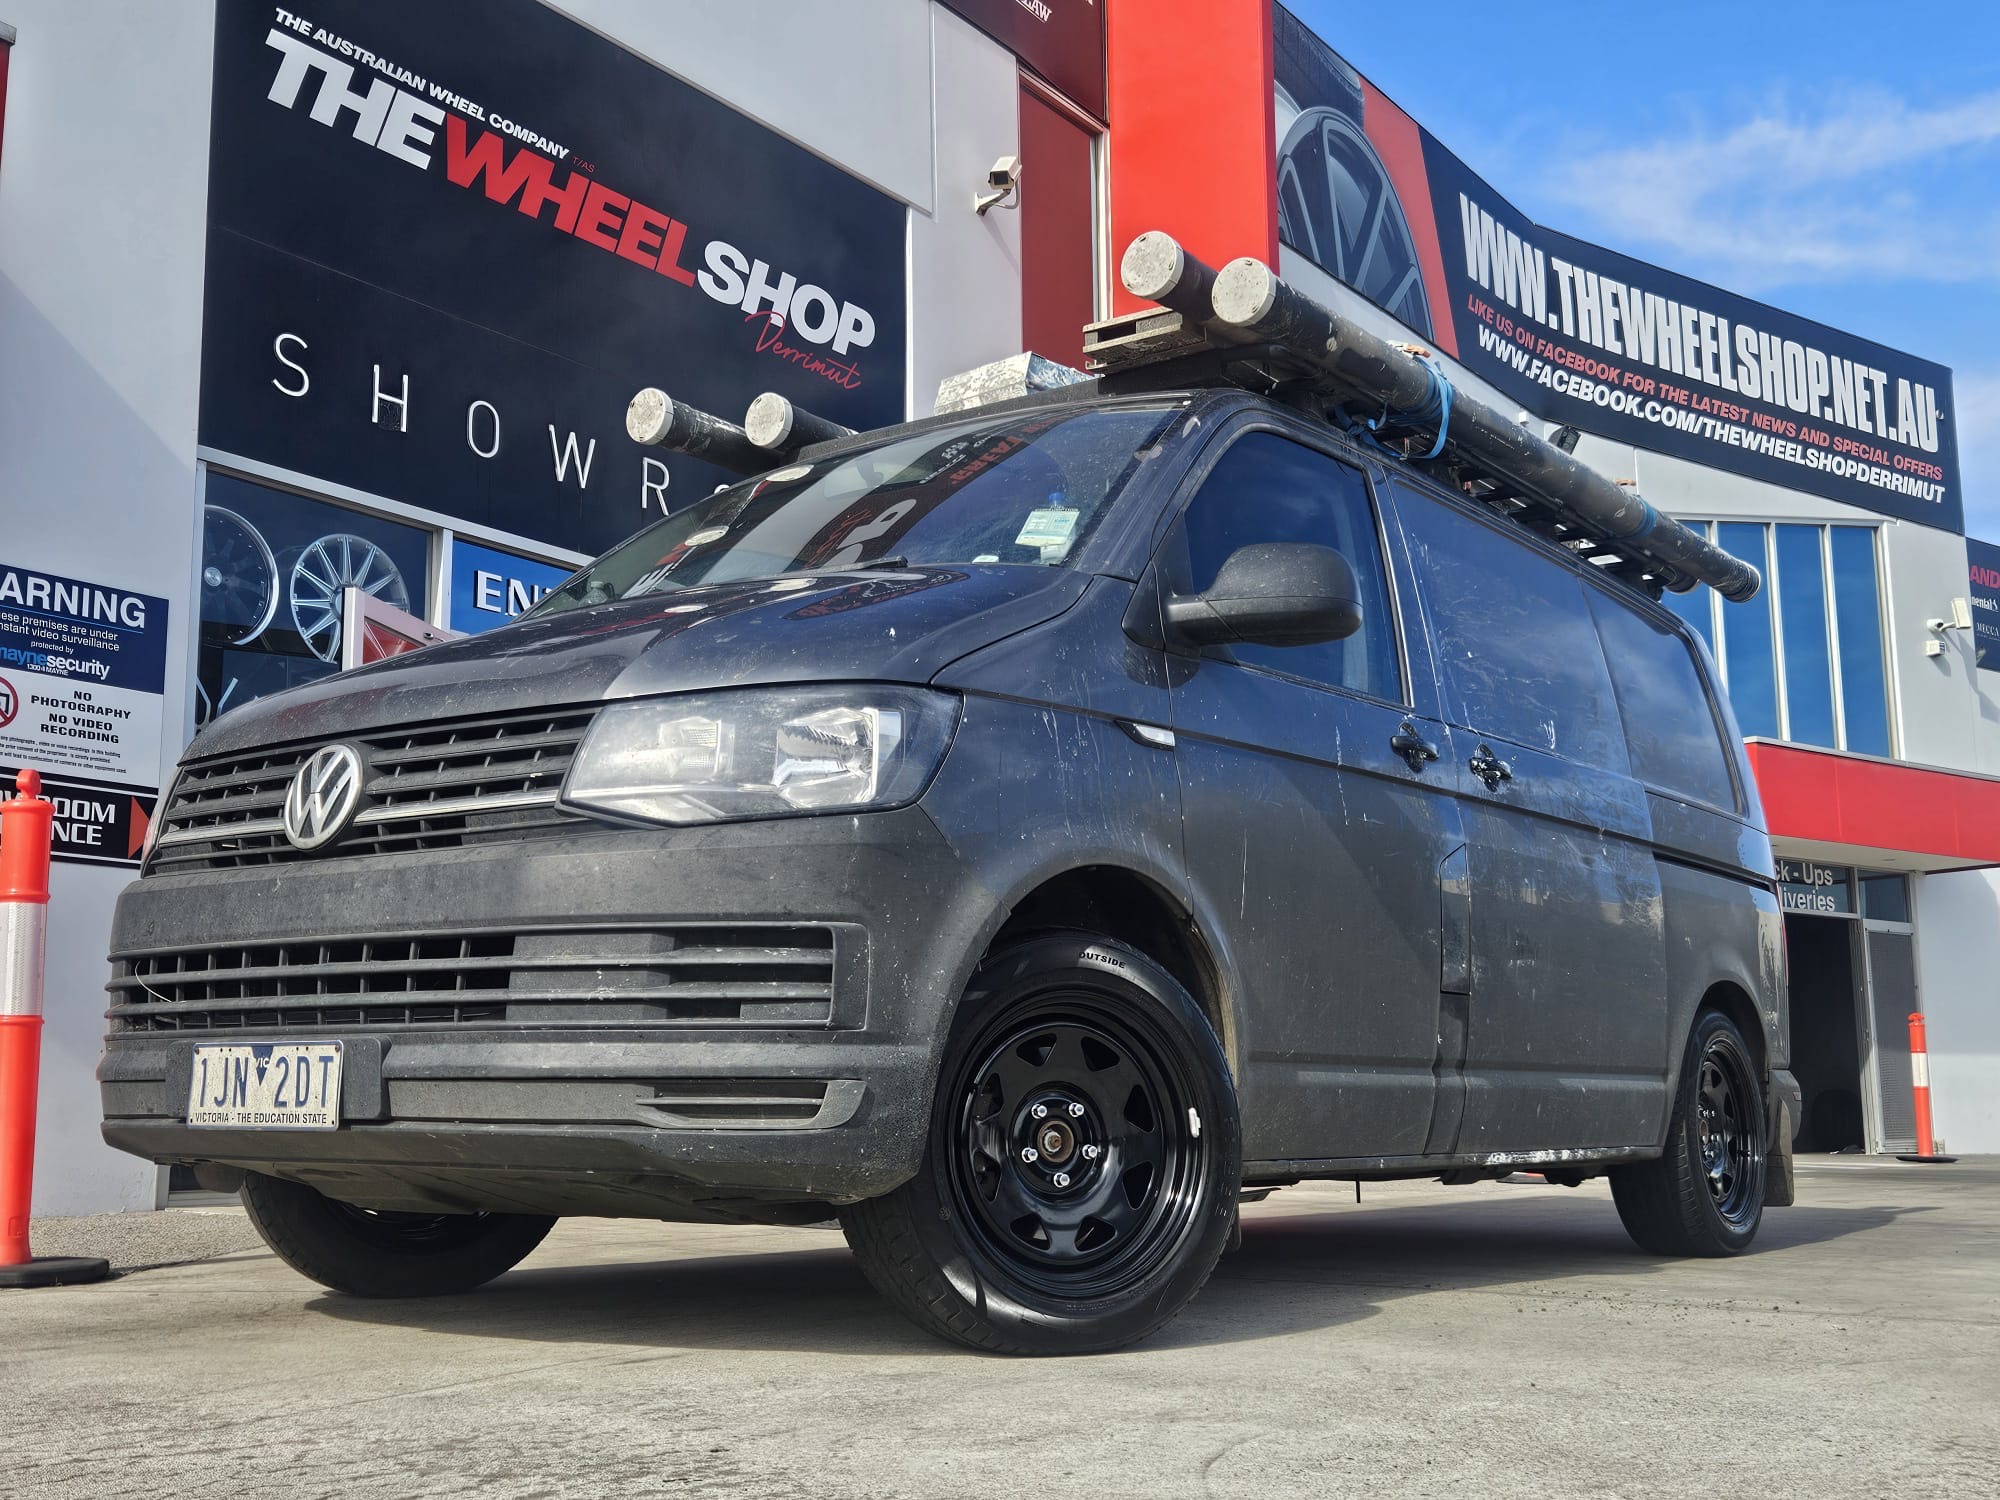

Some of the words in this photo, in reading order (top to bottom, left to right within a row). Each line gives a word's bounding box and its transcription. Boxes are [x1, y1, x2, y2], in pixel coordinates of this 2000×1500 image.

[275, 7, 312, 36] THE
[313, 28, 426, 91] AUSTRALIAN
[429, 82, 486, 122] WHEEL
[489, 113, 570, 160] COMPANY
[573, 156, 595, 173] T/AS
[265, 28, 446, 171] THE
[446, 112, 696, 288] WHEEL
[698, 240, 876, 355] SHOP
[1459, 191, 1939, 453] WWW.THEWHEELSHOP.NET.AU
[1467, 293, 1494, 325] LIKE
[1496, 315, 1513, 337] US
[1515, 327, 1537, 350] ON
[1536, 338, 1621, 384] FACEBOOK
[1622, 371, 1656, 395] FOR
[1659, 383, 1690, 404] THE
[1691, 392, 1750, 423] LATEST
[1751, 410, 1797, 438] NEWS
[1799, 426, 1830, 447] AND
[1832, 436, 1891, 466] SPECIAL
[1893, 454, 1943, 481] OFFERS
[273, 333, 730, 516] SHOWR
[1478, 324, 1946, 503] WWW.FACEBOOK.COM/THEWHEELSHOPDERRIMUT
[475, 569, 553, 617] EN
[22, 615, 69, 632] premises
[71, 625, 87, 636] are
[90, 627, 118, 641] under
[32, 626, 59, 640] video
[62, 634, 120, 651] surveillance
[30, 641, 63, 652] protected
[65, 645, 74, 655] by
[30, 695, 131, 719] PHOTOGRAPHY
[73, 690, 92, 701] NO
[40, 723, 119, 744] RECORDING
[48, 713, 67, 724] NO
[72, 716, 113, 731] VIDEO
[1802, 862, 1833, 890] Ups
[1078, 951, 1126, 969] OUTSIDE
[200, 1056, 249, 1108] 1JN
[274, 1055, 334, 1108] 2DT
[195, 1112, 229, 1123] VICTORIA
[237, 1112, 251, 1123] THE
[254, 1112, 300, 1124] EDUCATION
[302, 1113, 327, 1124] STATE
